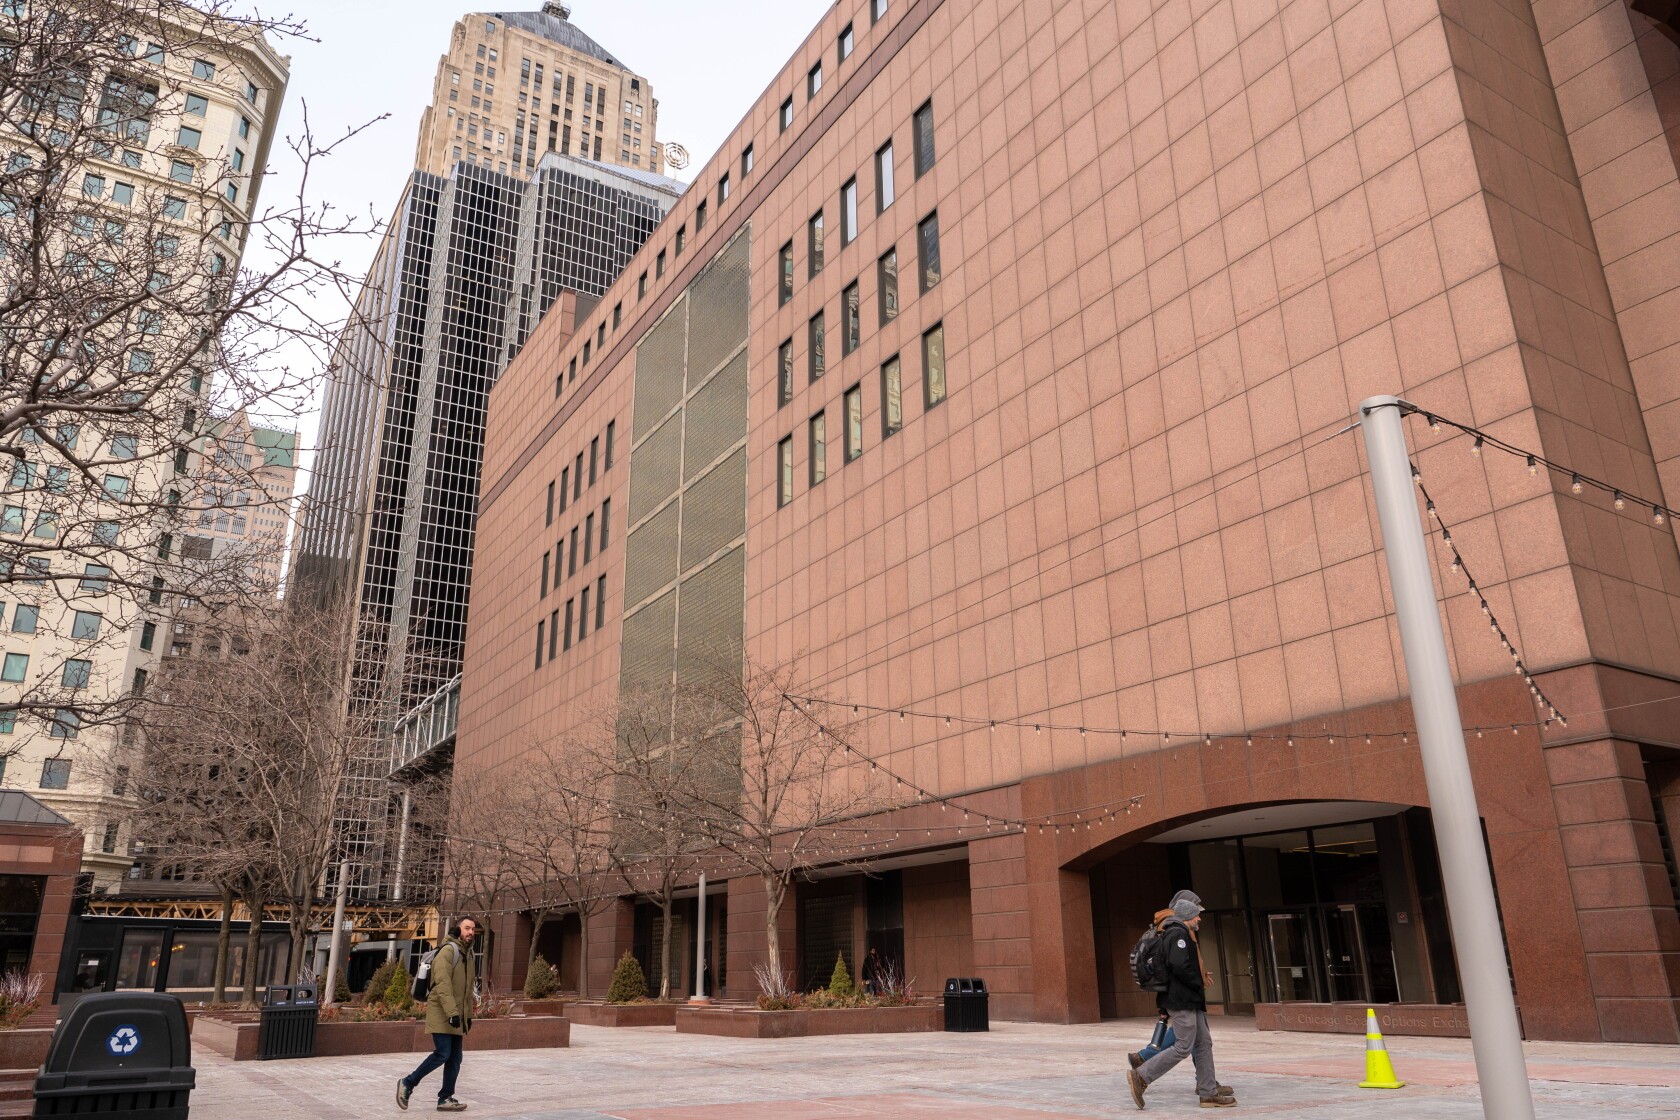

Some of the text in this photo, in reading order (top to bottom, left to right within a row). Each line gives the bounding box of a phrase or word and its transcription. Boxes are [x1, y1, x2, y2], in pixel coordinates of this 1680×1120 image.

[1273, 1013, 1470, 1029] The Chicago Boa Options Excha
